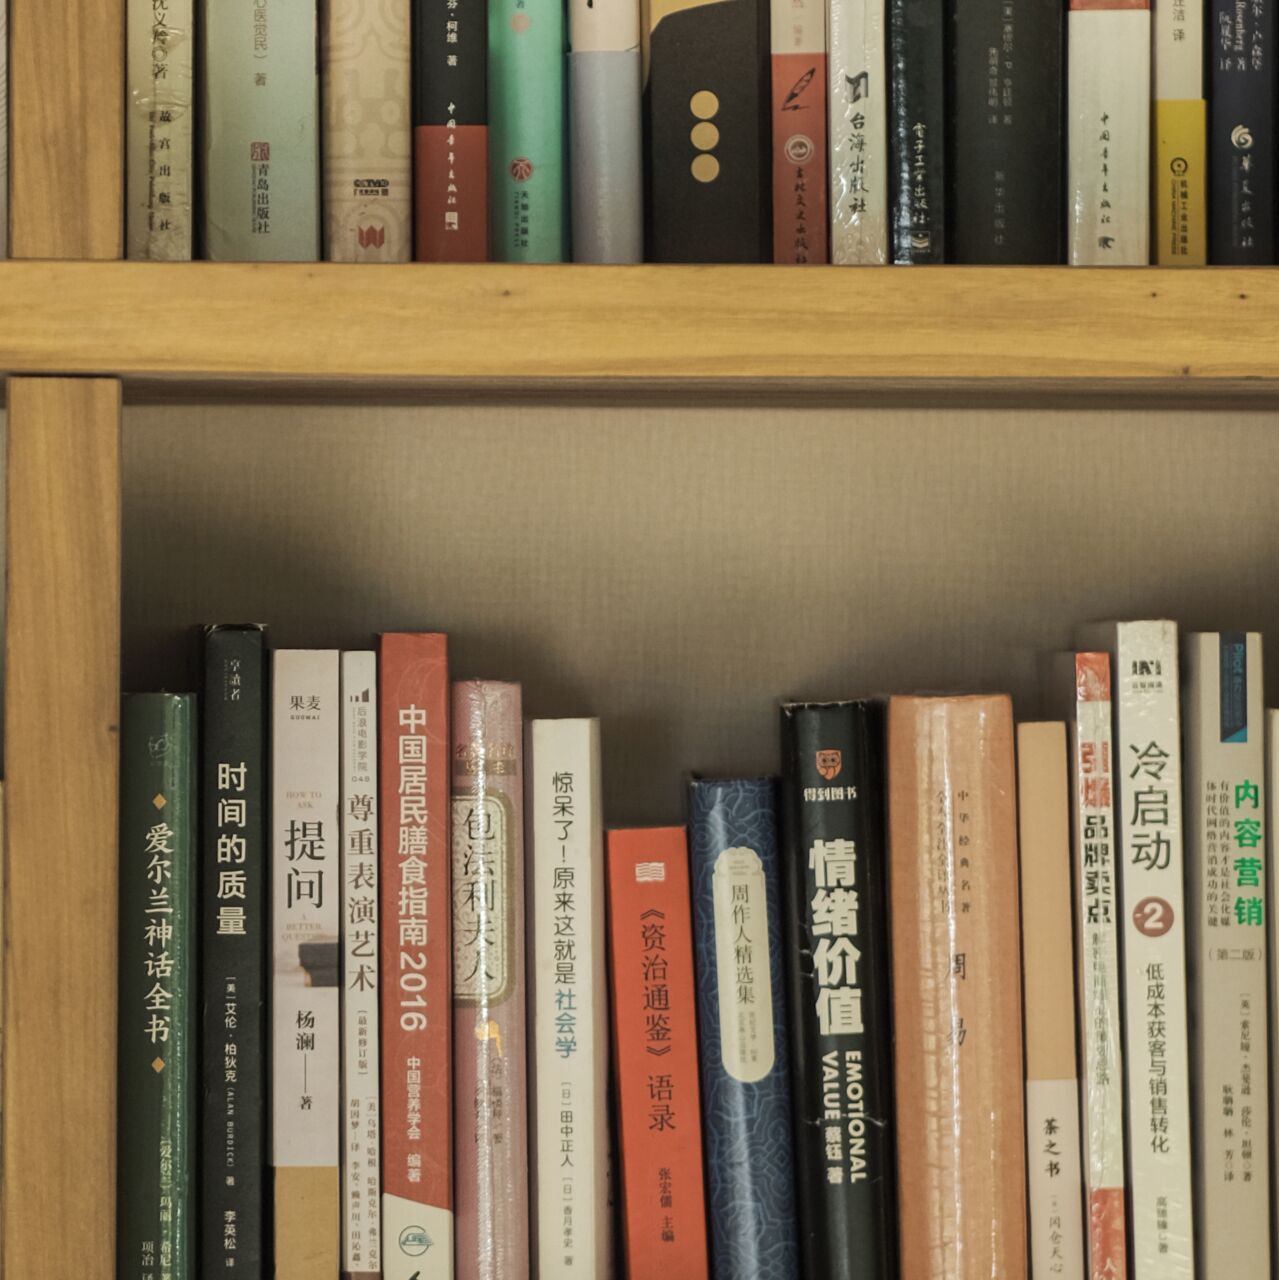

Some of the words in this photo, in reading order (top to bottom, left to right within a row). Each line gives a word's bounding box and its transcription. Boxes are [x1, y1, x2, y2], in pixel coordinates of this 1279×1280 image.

[257, 164, 270, 235] 青岛出版社
[848, 112, 868, 214] 台海出版社
[289, 694, 322, 712] 果麦
[803, 787, 858, 801] 得到图书
[1129, 740, 1172, 873] 冷启动
[216, 761, 249, 937] 时间的质量
[284, 819, 327, 910] 提问
[346, 793, 378, 993] 尊重表演艺术
[1233, 778, 1263, 928] 内容营销
[142, 821, 175, 1044] 爱尔兰神话全书
[730, 883, 755, 1005] 周作人精选集
[809, 837, 865, 1036] 情绪价值
[1142, 901, 1165, 929] 2
[296, 1010, 316, 1052] 杨澜
[1146, 962, 1170, 1155] 低成本获客与销售转化
[406, 1055, 421, 1141] 中国营养学会
[821, 1051, 841, 1121] VALUE
[844, 1050, 867, 1184] EMOTIONAL
[1043, 1116, 1061, 1178] 茶之书
